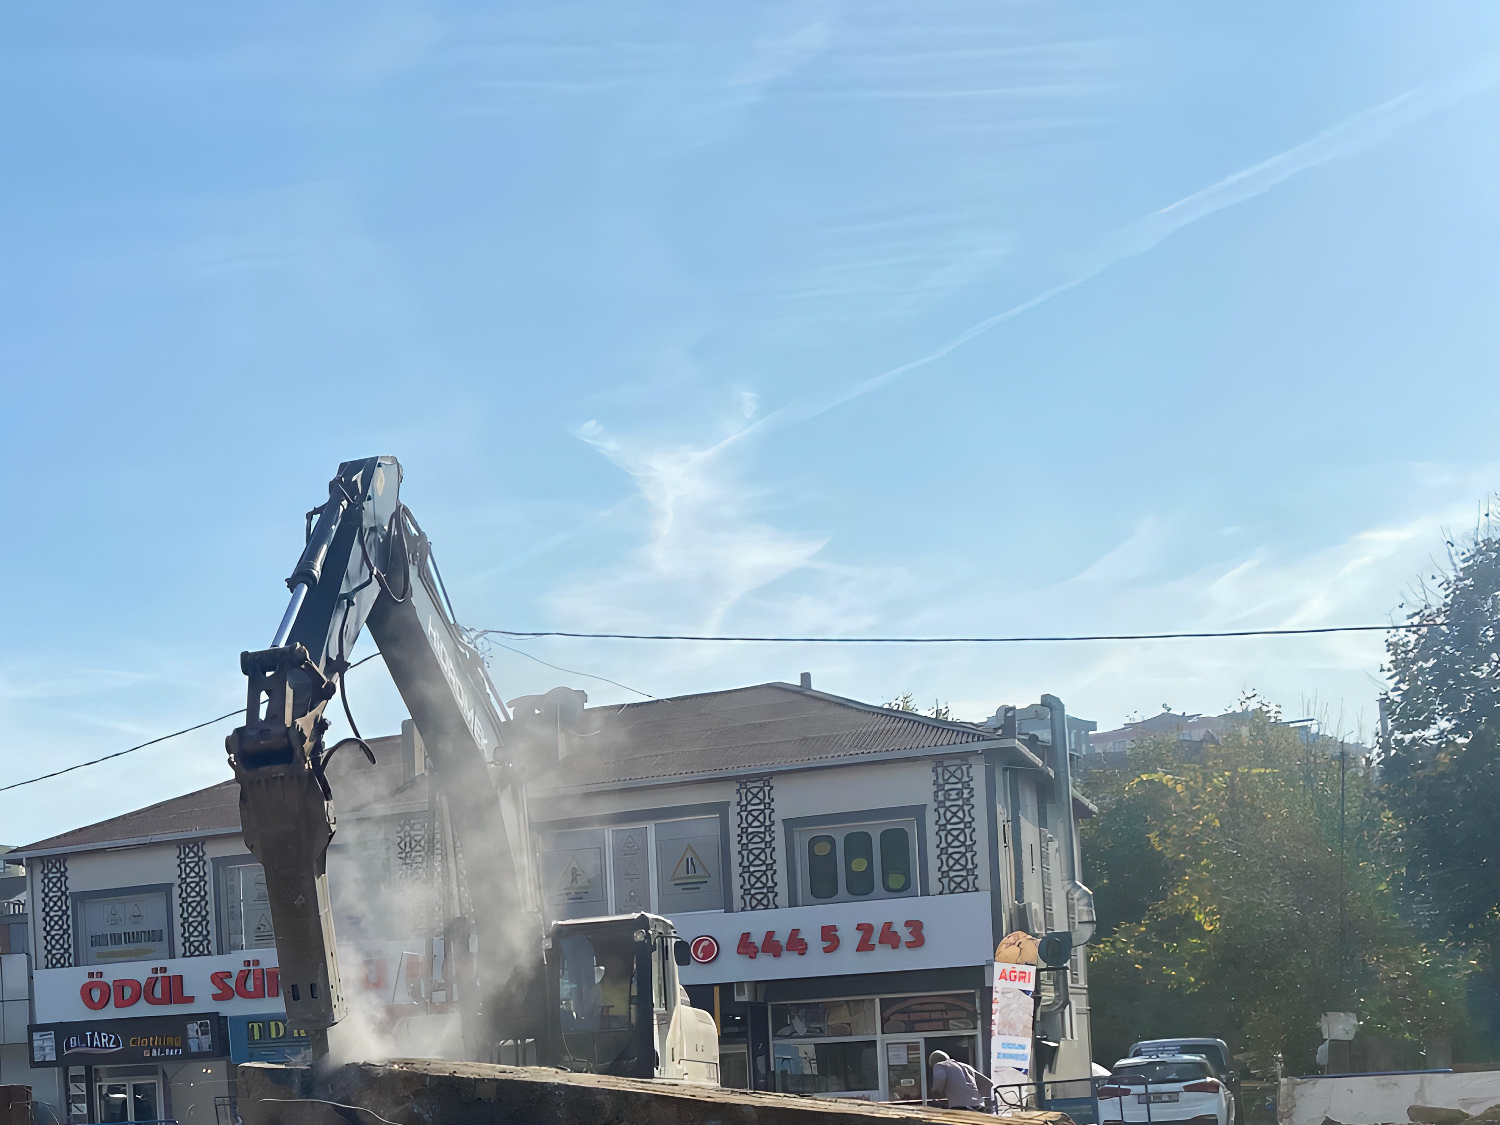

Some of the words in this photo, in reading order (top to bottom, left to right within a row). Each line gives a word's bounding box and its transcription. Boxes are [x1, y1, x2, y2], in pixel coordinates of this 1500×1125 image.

[737, 929, 808, 959] 444
[821, 925, 840, 953] 5
[856, 920, 925, 952] 243
[80, 966, 195, 1010] ÖDÜL
[998, 967, 1031, 984] AĞRI
